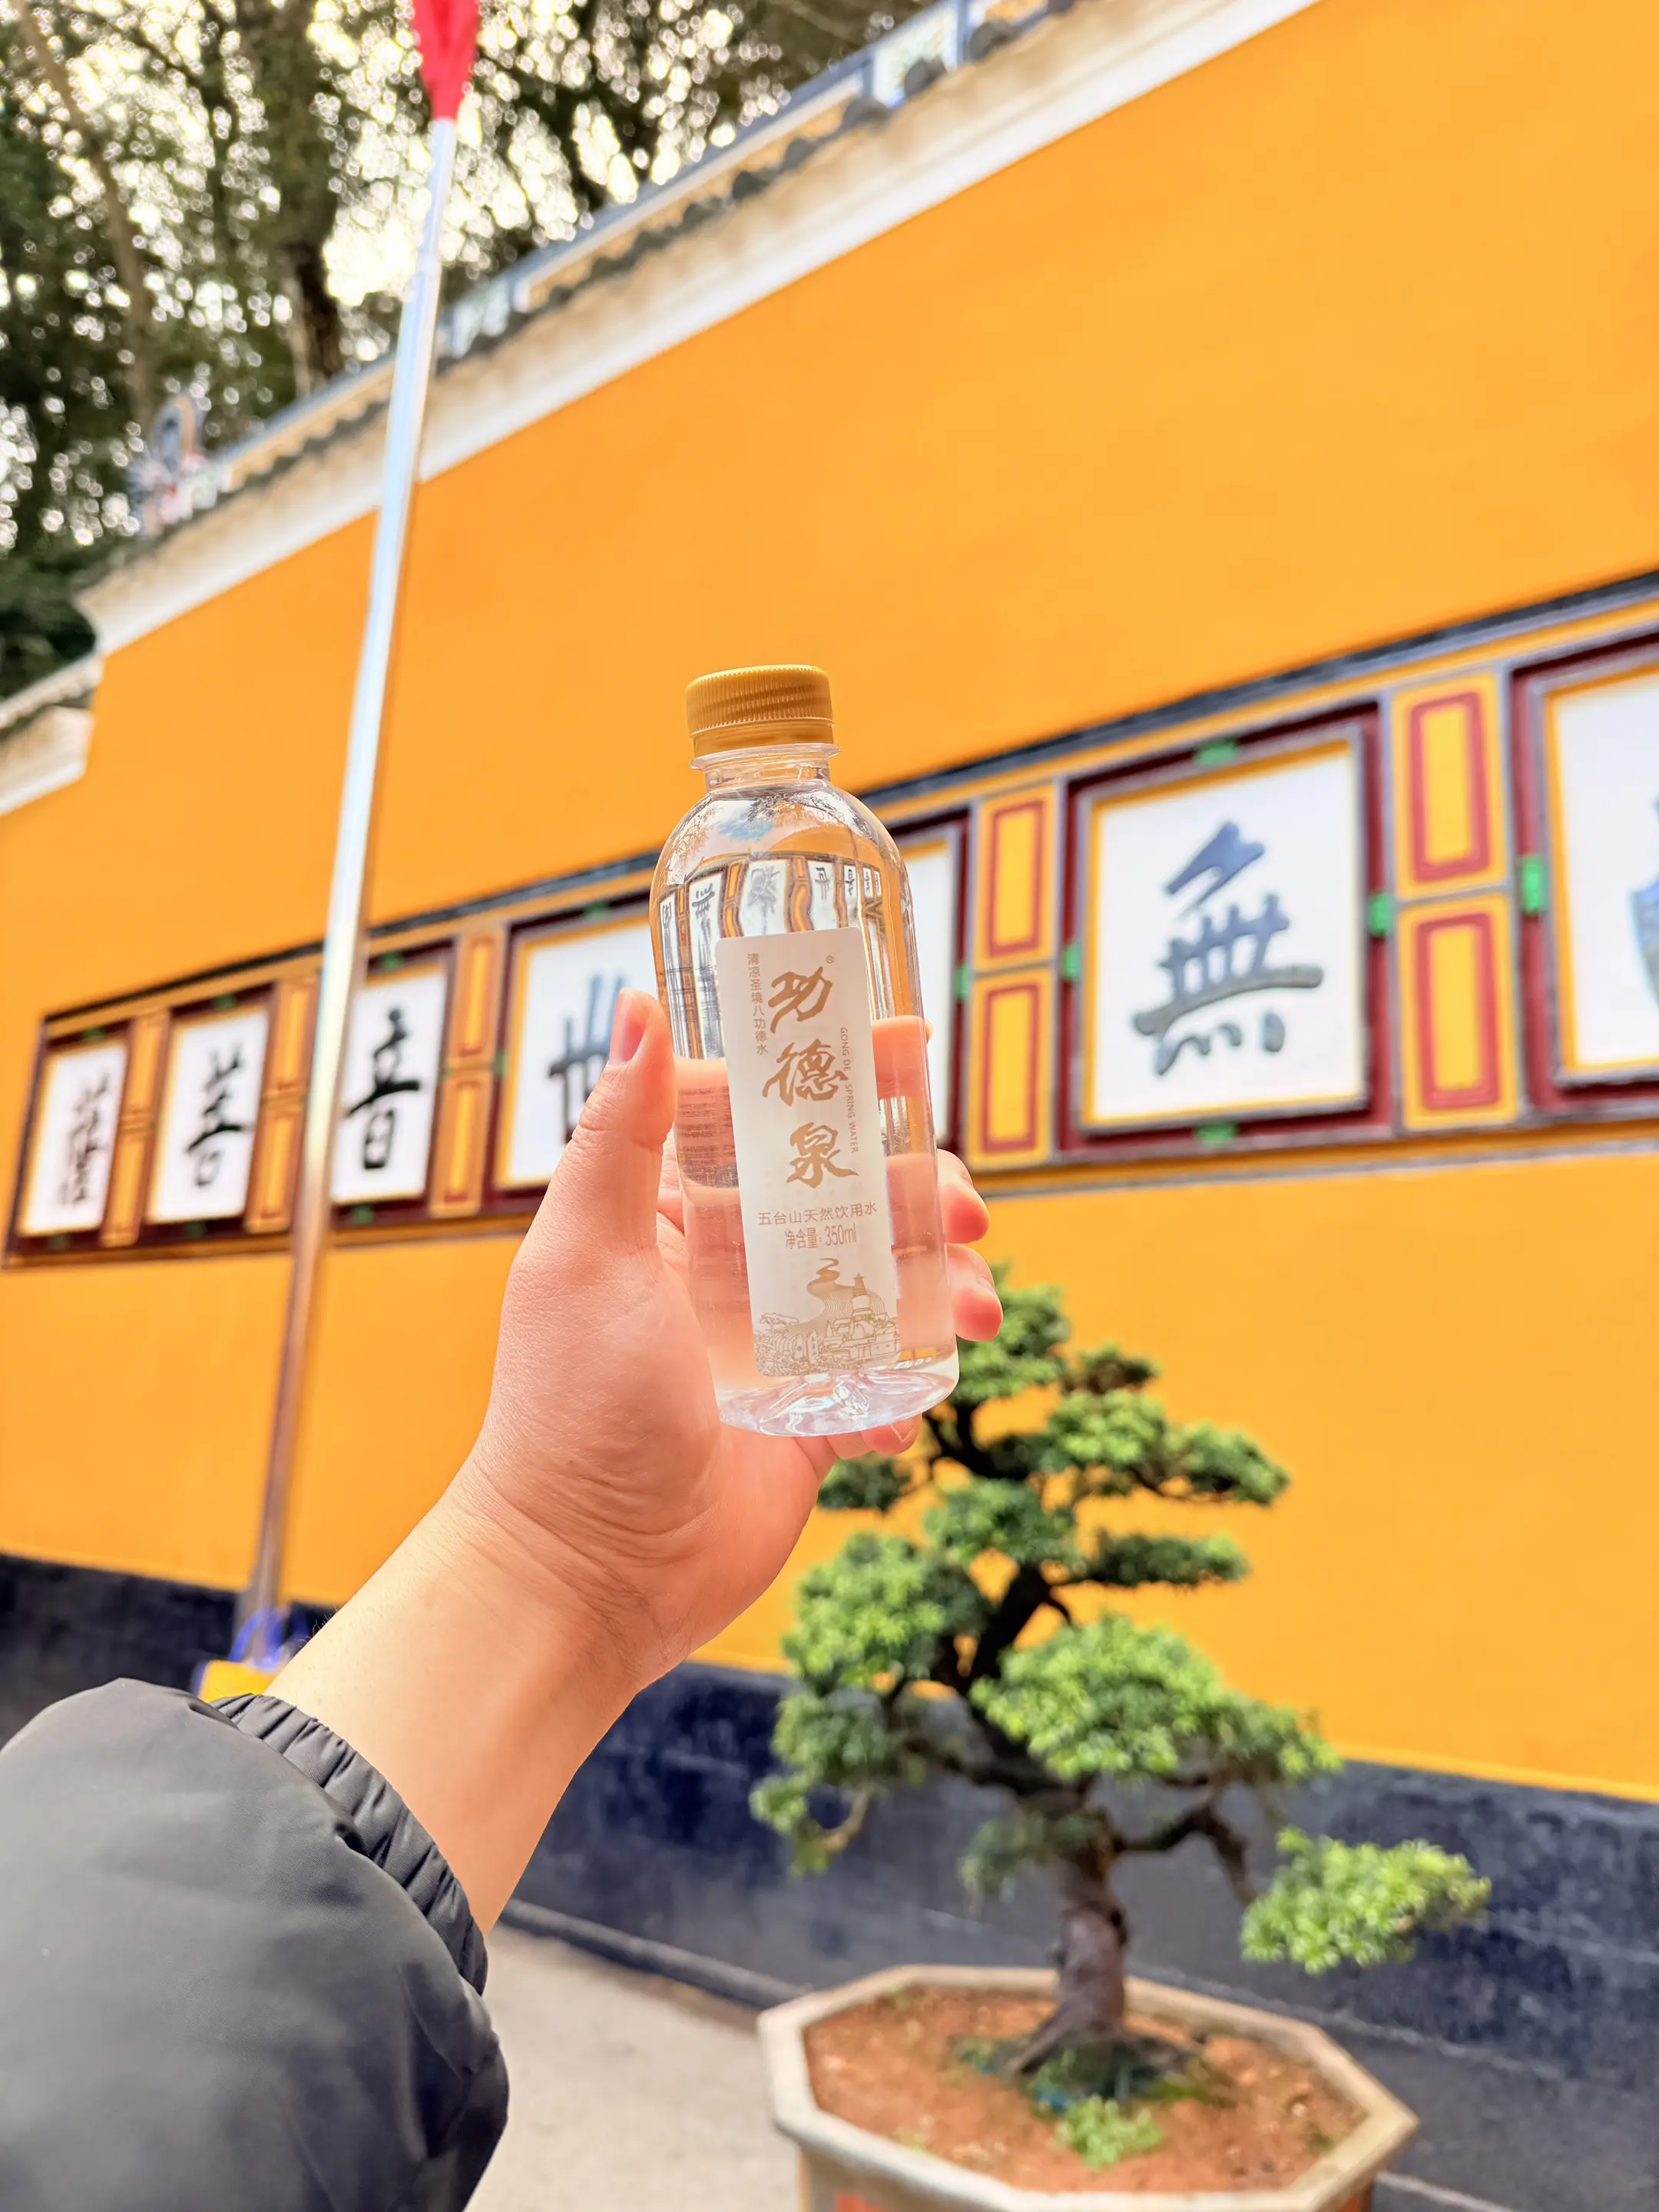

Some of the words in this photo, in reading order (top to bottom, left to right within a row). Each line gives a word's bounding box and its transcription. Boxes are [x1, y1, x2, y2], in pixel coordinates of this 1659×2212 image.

[839, 1026, 850, 1056] GONG
[762, 965, 859, 1189] 功德泉
[843, 1059, 851, 1071] DE
[845, 1083, 856, 1119] SPRING
[849, 1121, 859, 1154] WATER
[757, 1201, 877, 1226] 五台山天然饮用水
